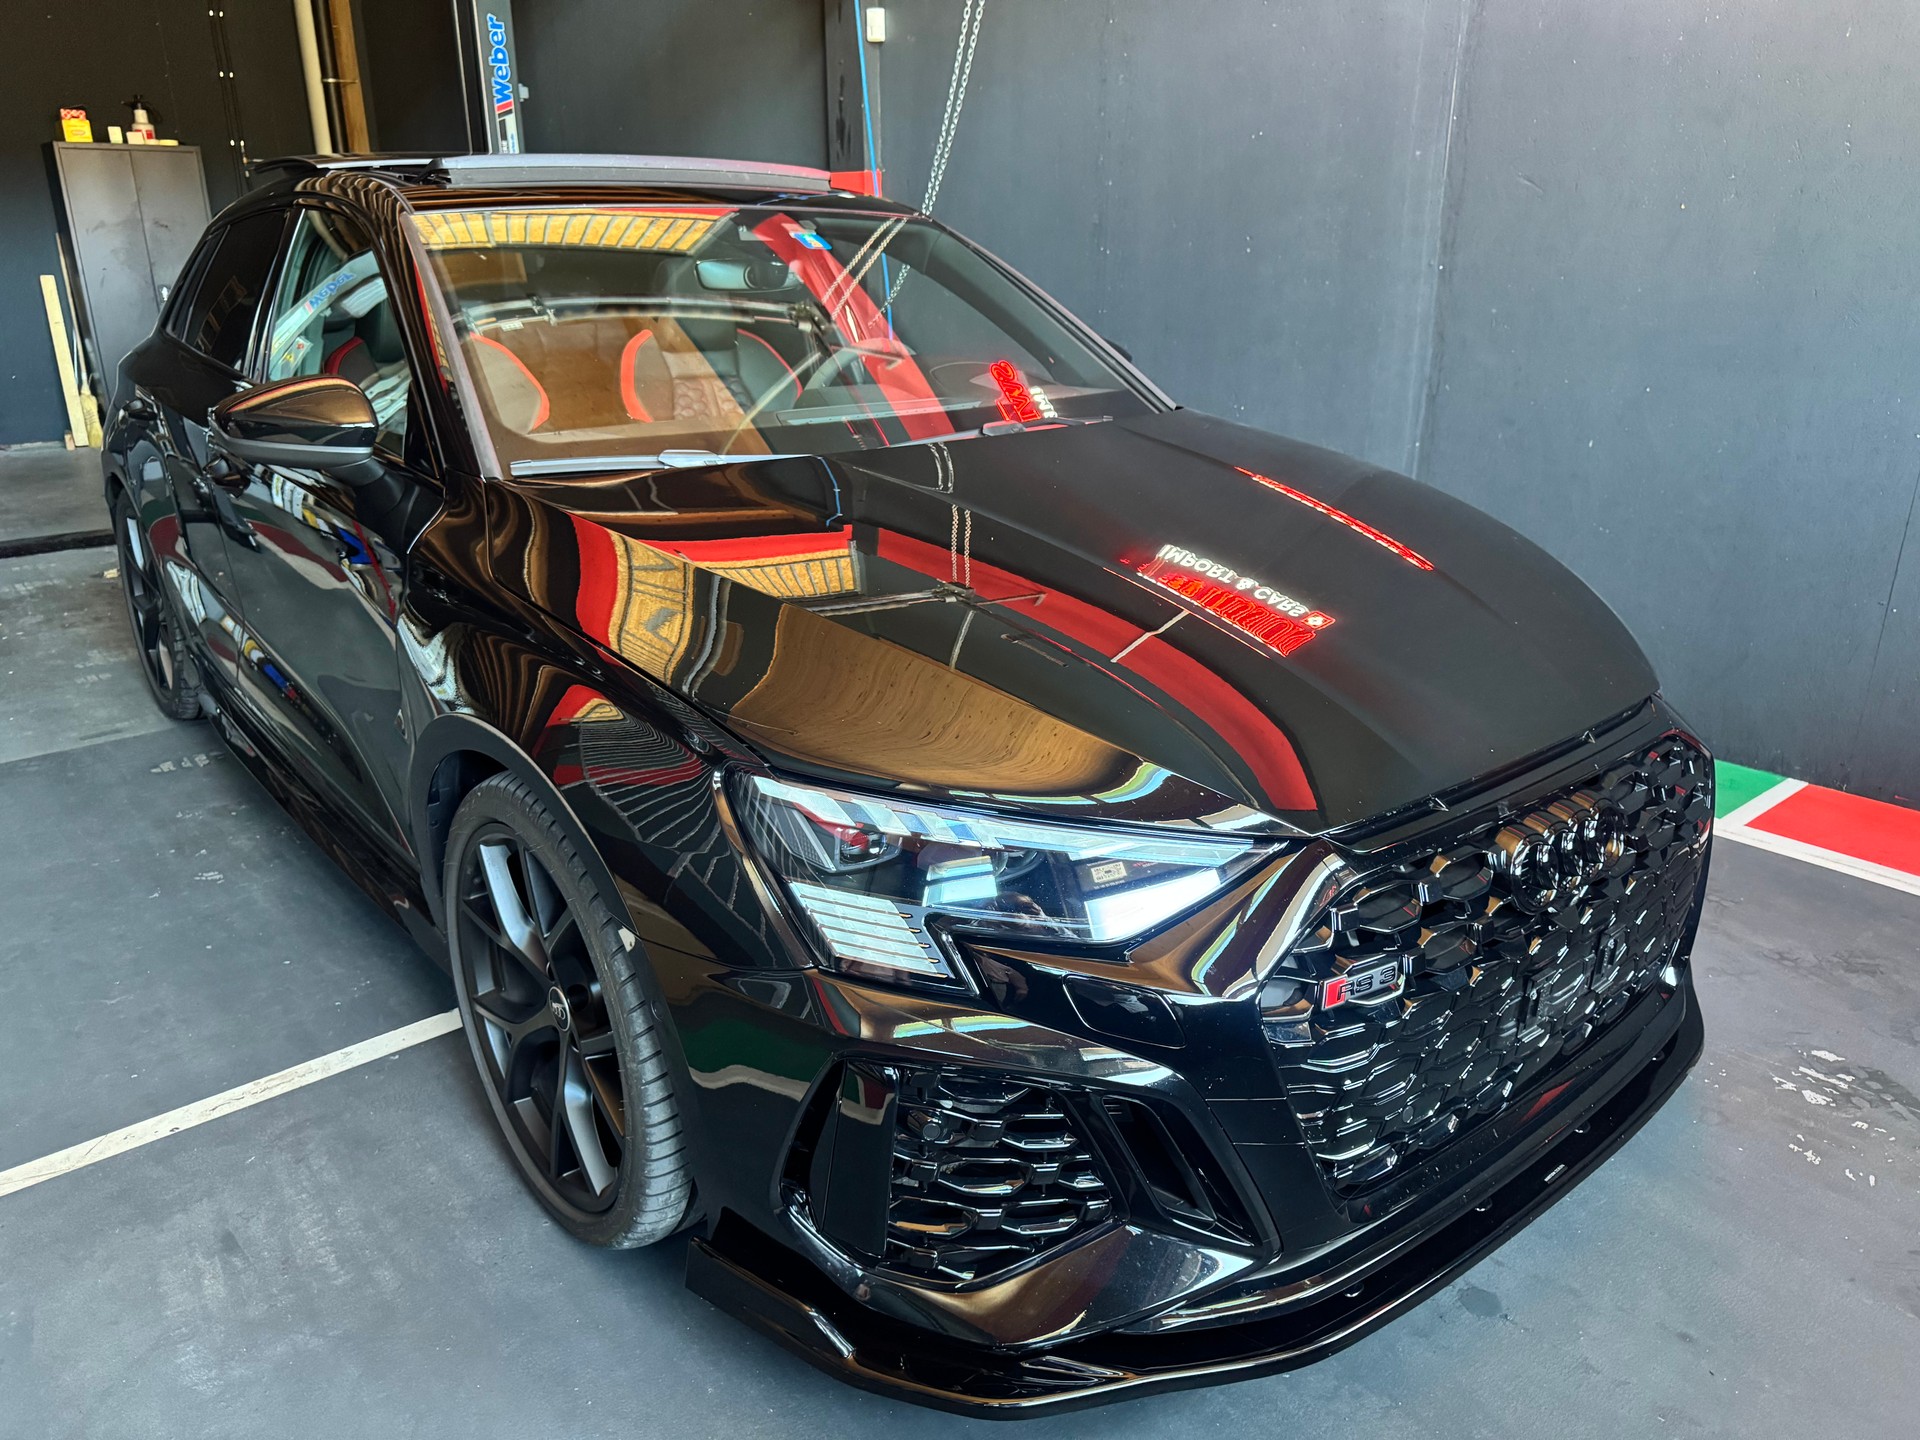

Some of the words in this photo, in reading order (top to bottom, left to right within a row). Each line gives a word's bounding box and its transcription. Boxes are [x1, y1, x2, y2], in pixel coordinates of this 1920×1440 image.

[487, 13, 513, 105] Weber
[1335, 973, 1375, 1001] RS
[1379, 965, 1397, 985] 3
